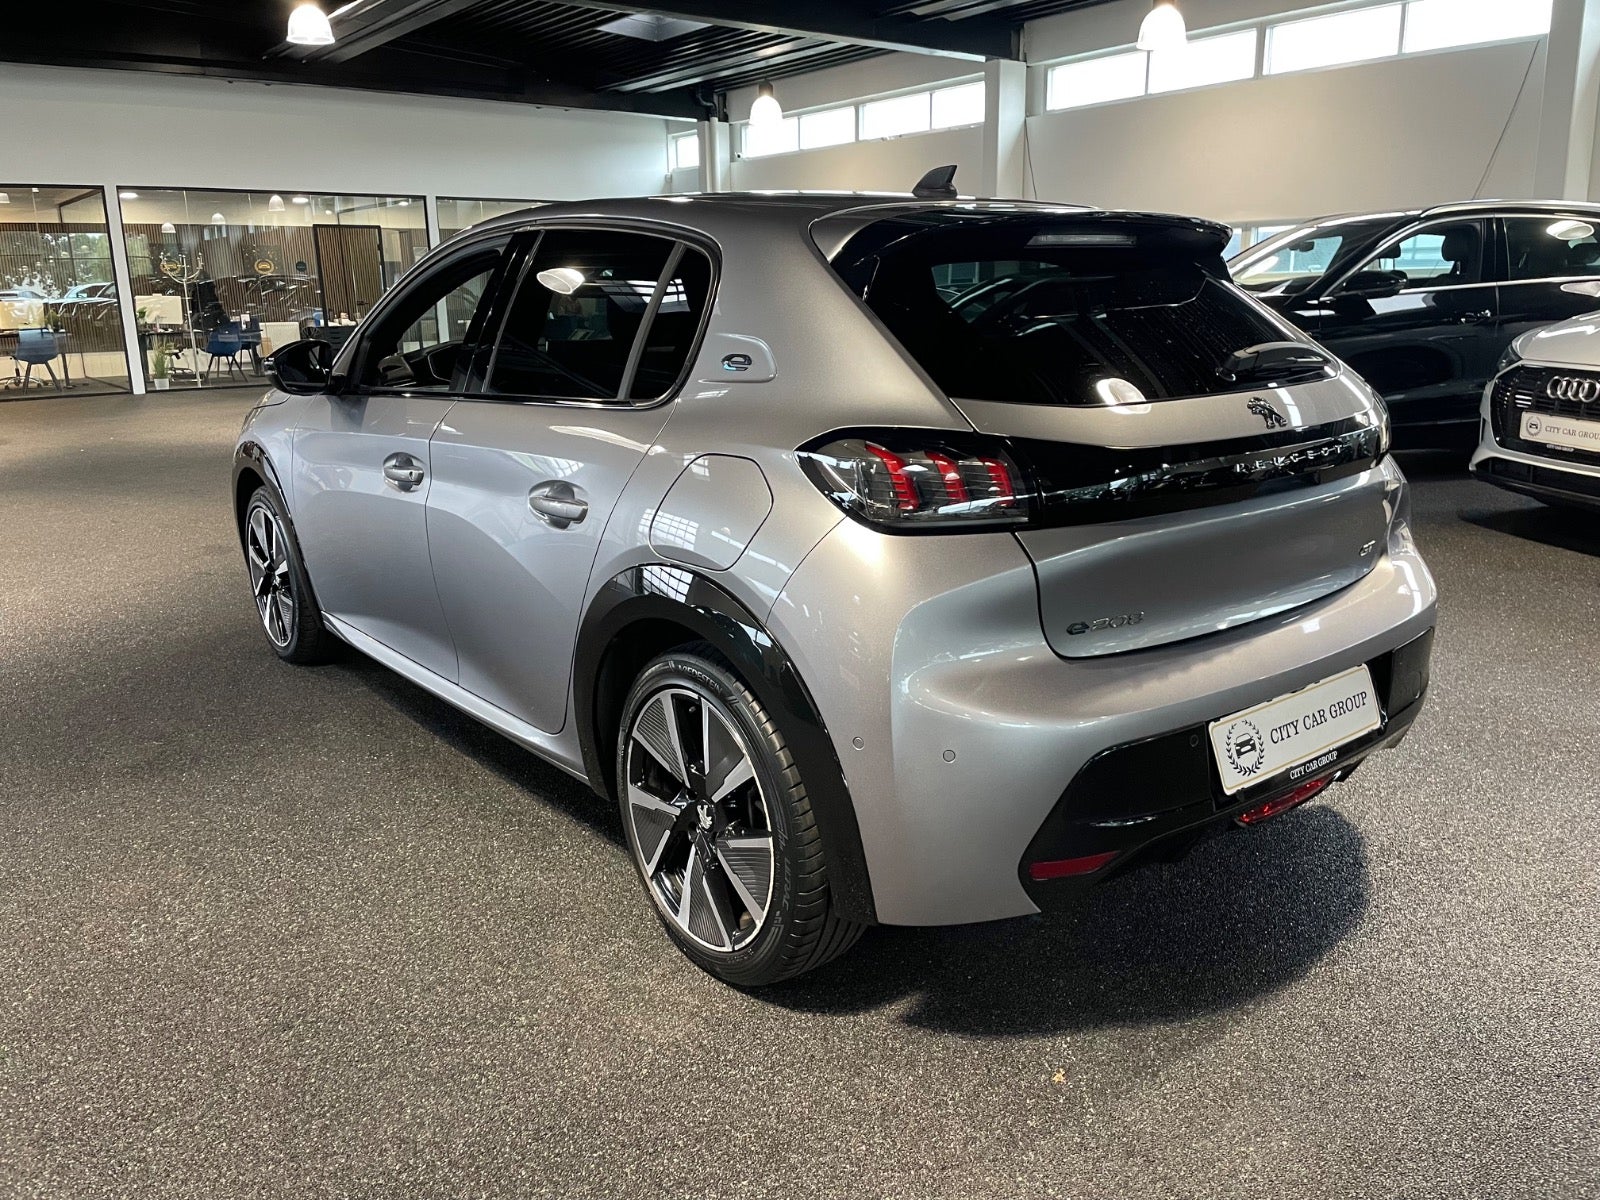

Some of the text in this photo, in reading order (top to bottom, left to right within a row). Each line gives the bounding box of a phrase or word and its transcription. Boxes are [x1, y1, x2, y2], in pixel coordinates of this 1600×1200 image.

[1545, 425, 1600, 440] CITY CAR GROU
[1270, 691, 1368, 744] CITY CAR GROUP
[1290, 750, 1338, 780] CITY CAR GROUP
